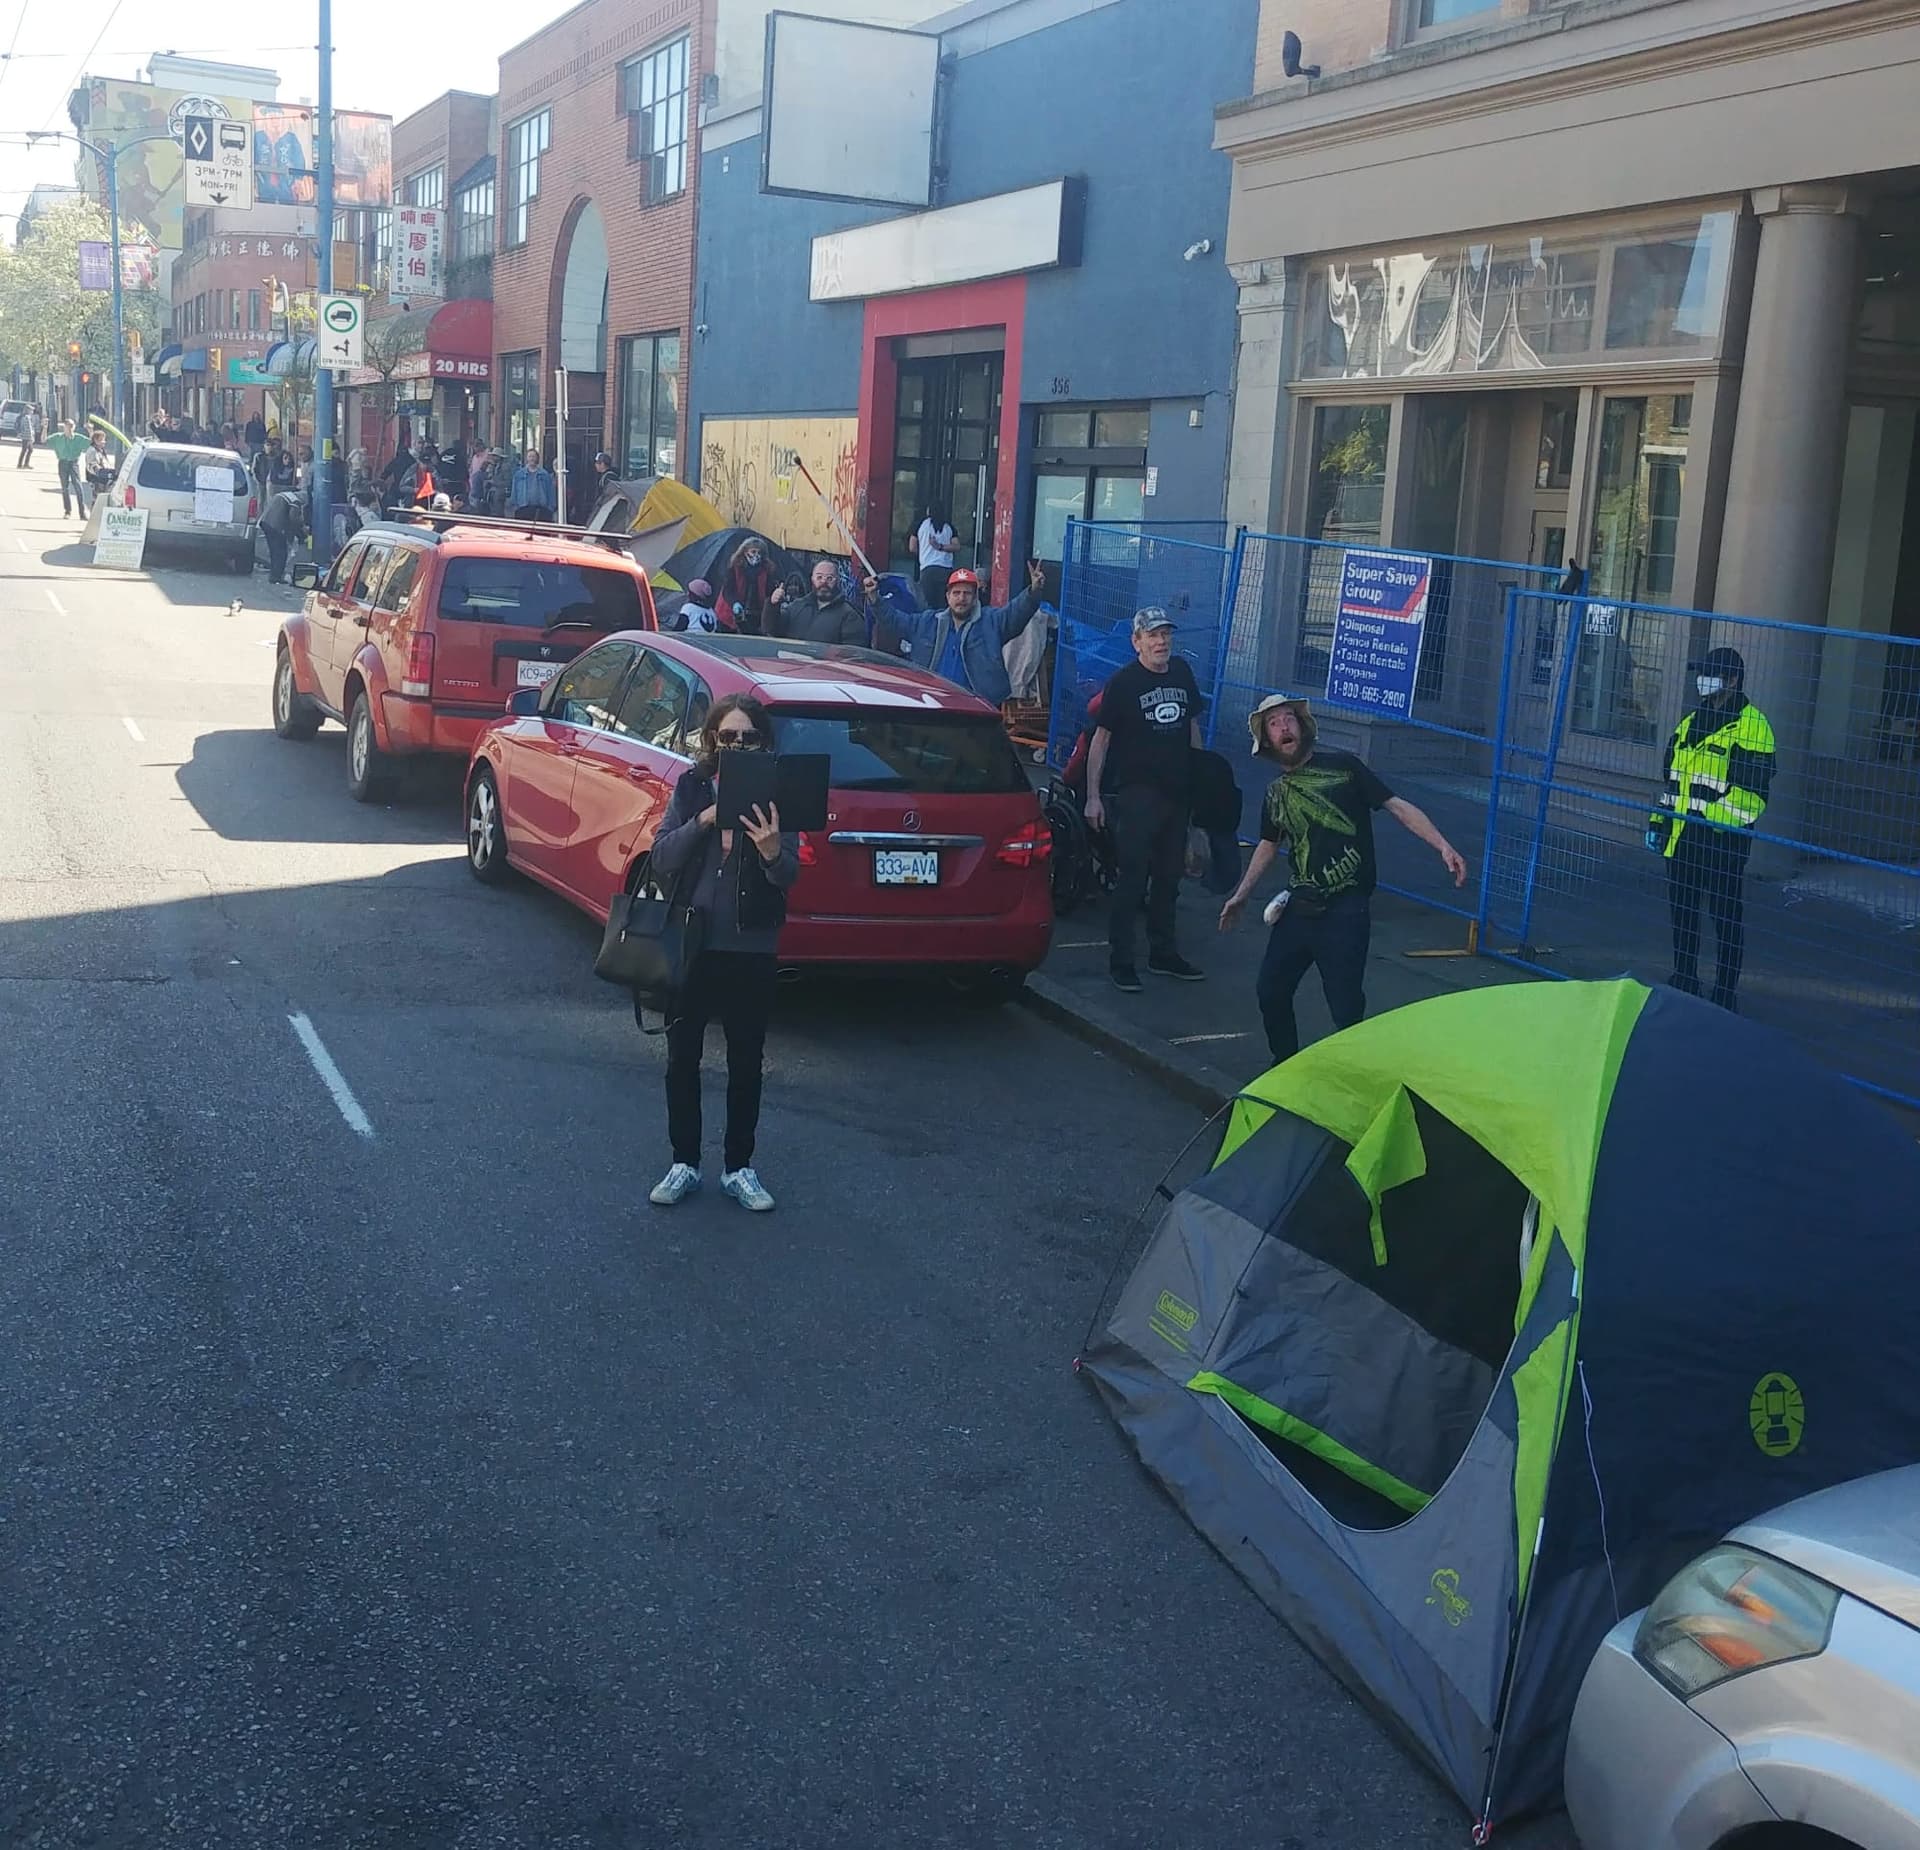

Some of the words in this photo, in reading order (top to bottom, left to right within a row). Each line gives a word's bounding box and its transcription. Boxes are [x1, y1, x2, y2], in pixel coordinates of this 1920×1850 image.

[435, 359, 454, 373] 20
[458, 363, 488, 376] HRS
[1347, 562, 1385, 584] Super
[1385, 567, 1417, 587] Save
[1345, 582, 1383, 604] Group
[1592, 613, 1611, 625] WET
[1343, 634, 1370, 648] Fence
[1372, 638, 1408, 655] Rentals
[1341, 648, 1368, 663] Toilet
[1370, 652, 1406, 671] Rentals
[1322, 844, 1361, 888] high
